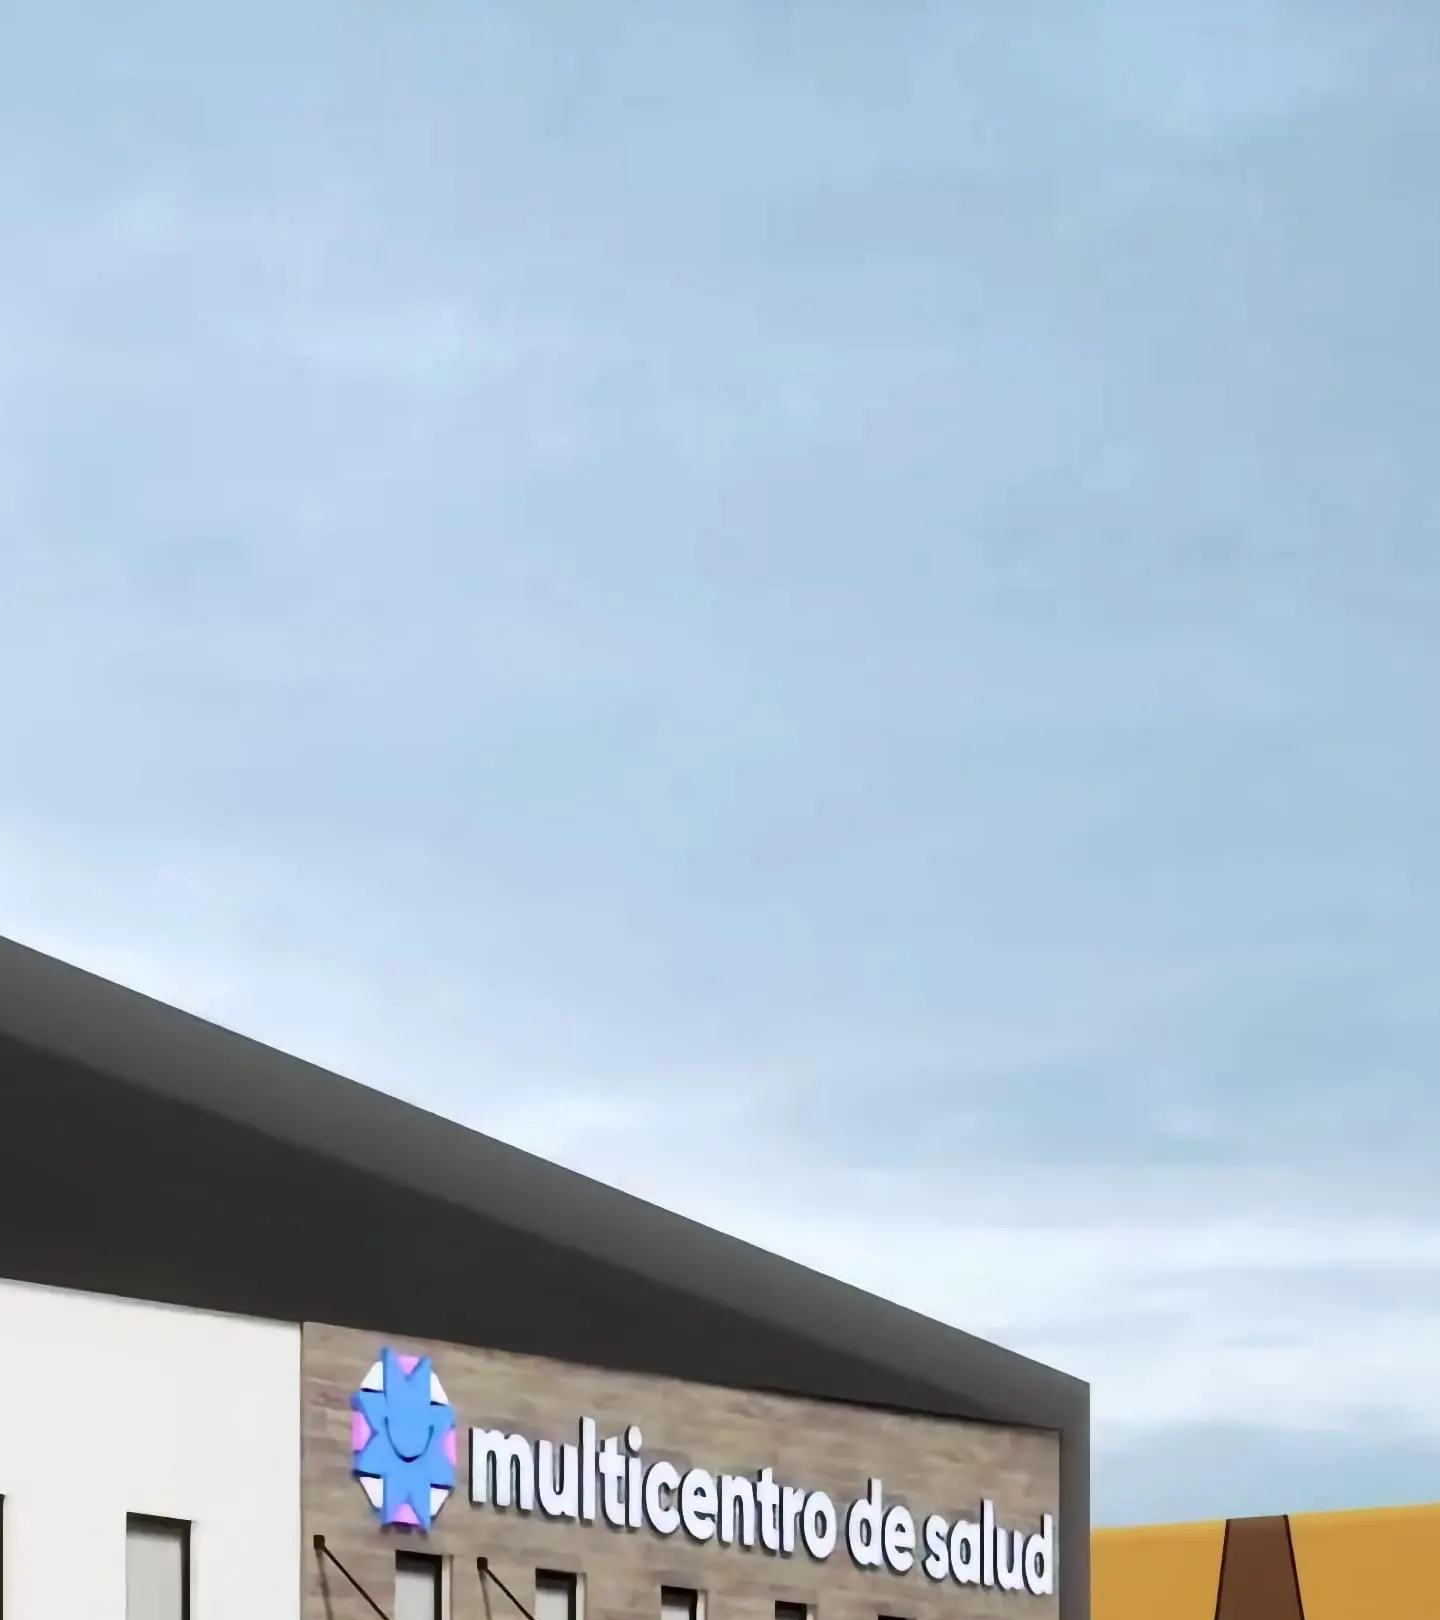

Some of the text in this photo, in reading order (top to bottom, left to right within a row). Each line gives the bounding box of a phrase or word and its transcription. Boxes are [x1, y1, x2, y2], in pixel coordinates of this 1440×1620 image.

[469, 1416, 1054, 1597] multicentro de salud
